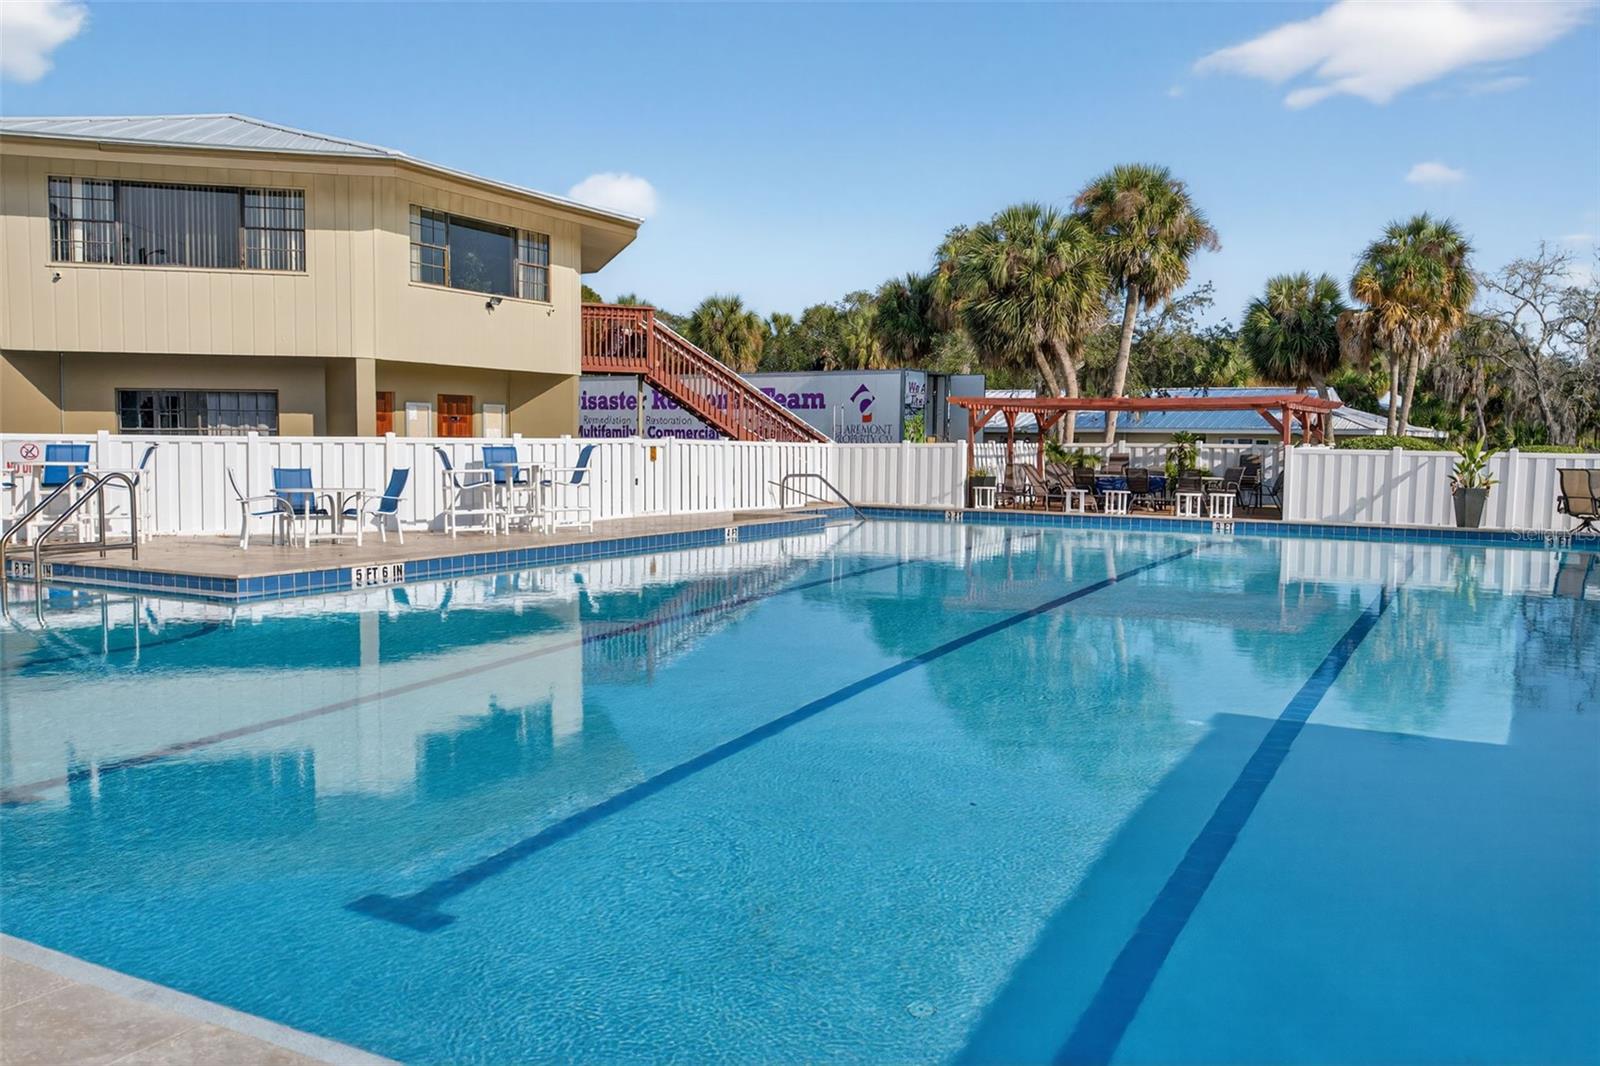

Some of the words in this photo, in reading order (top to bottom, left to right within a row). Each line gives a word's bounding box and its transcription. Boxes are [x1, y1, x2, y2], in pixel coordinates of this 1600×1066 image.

[583, 415, 632, 425] Remediation
[645, 415, 692, 425] Restoration
[366, 567, 378, 582] FT
[392, 564, 403, 580] IN
